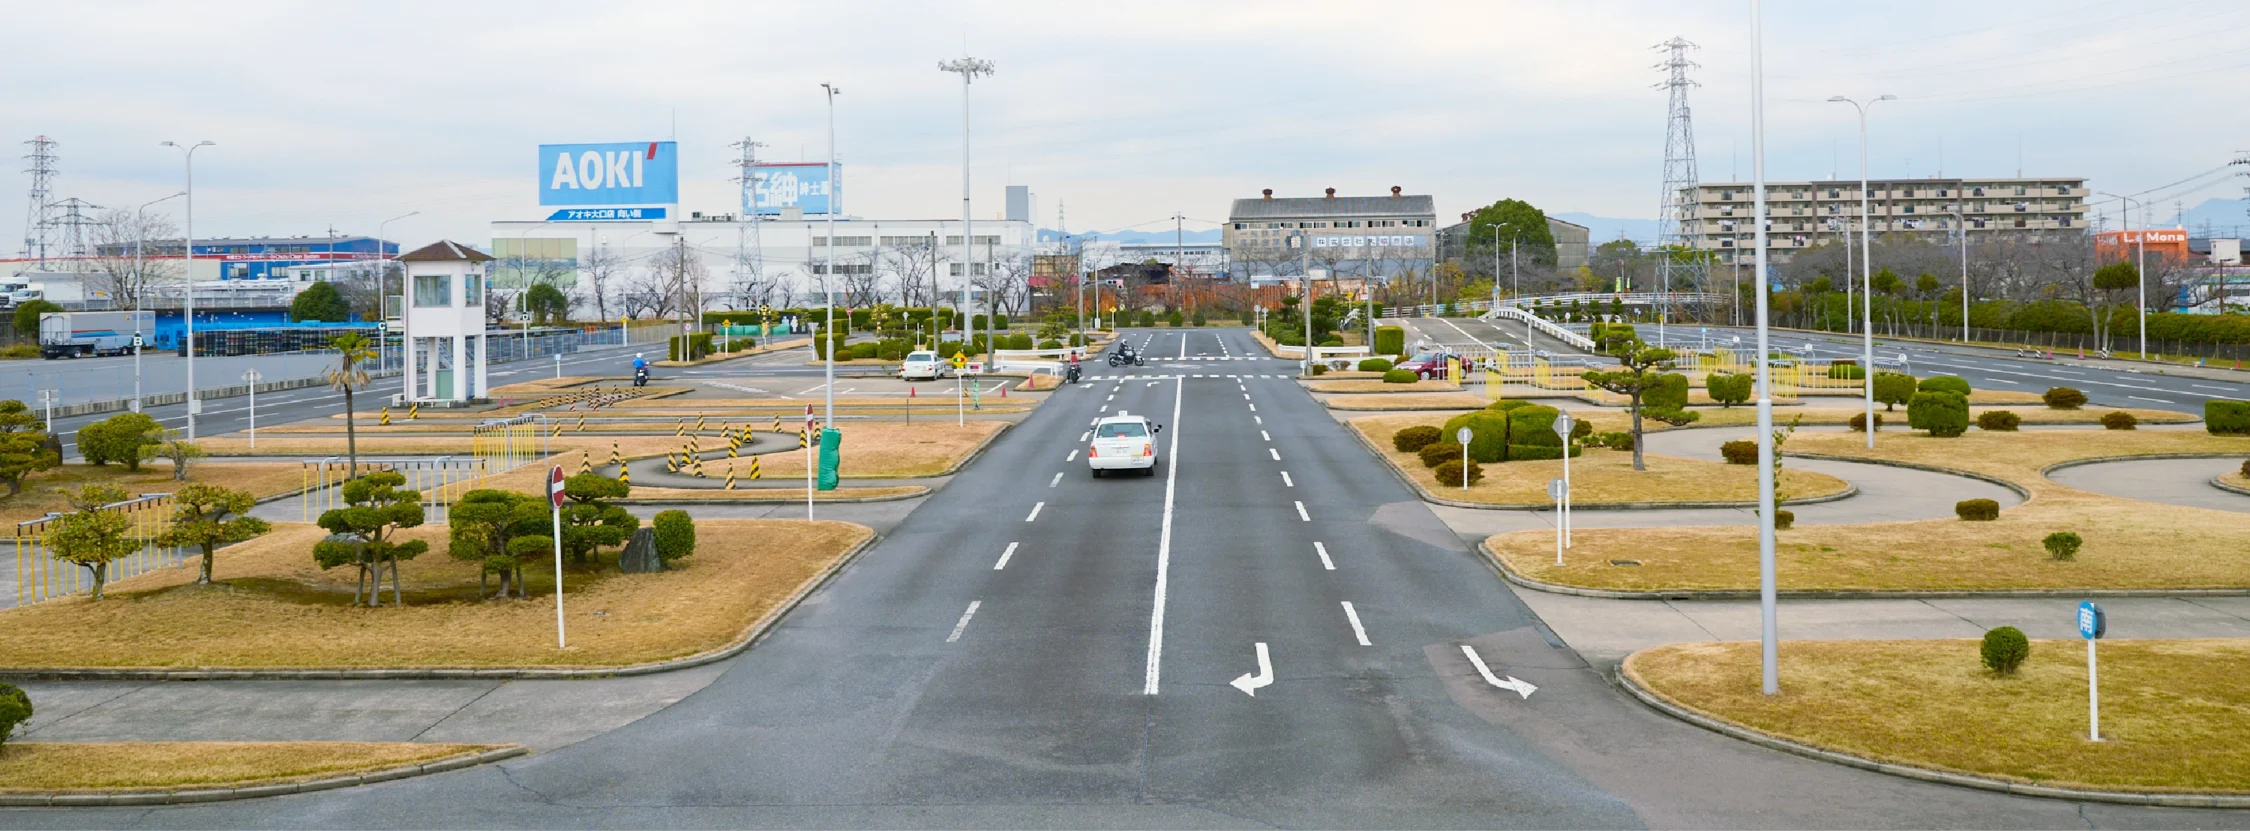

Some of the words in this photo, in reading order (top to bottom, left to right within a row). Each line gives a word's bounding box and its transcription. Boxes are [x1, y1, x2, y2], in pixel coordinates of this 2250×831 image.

[550, 150, 643, 190] AOKI
[2146, 231, 2185, 242] Mona
[378, 322, 386, 330] C
[133, 336, 144, 346] B
